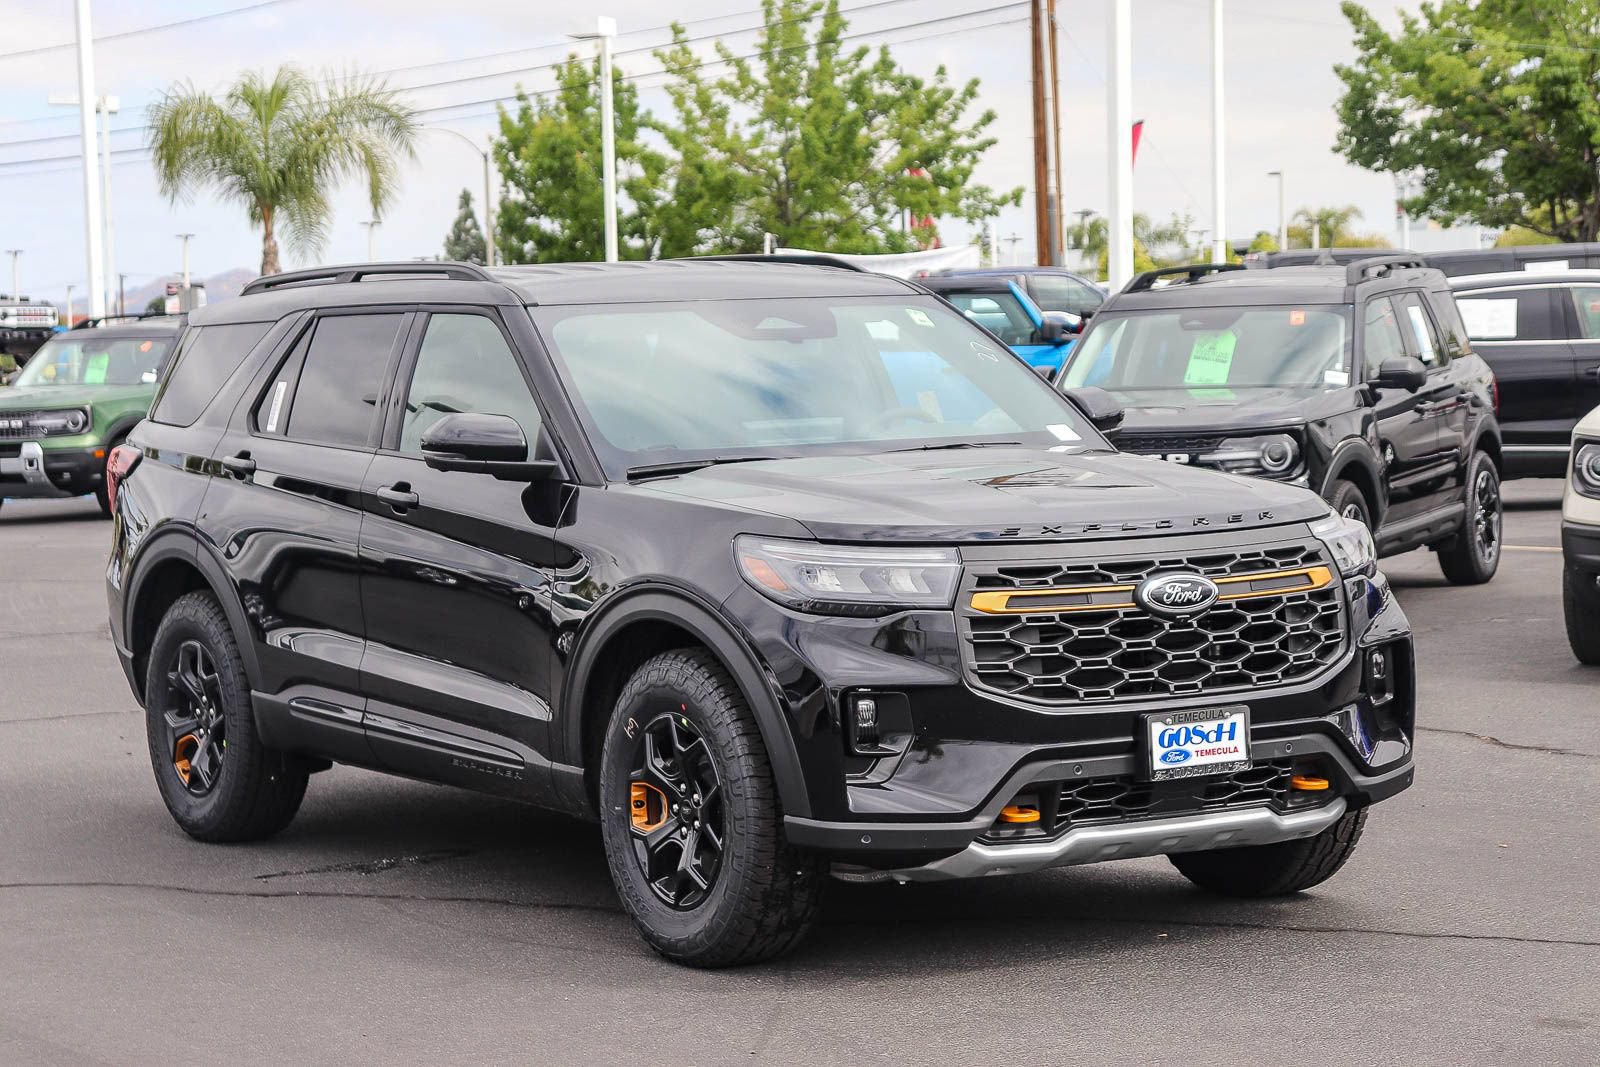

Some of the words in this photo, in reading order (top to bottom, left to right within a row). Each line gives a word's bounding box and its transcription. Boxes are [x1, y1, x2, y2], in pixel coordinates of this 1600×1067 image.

[1000, 510, 1274, 537] EXPLORER
[1163, 583, 1203, 603] Ford
[1172, 709, 1225, 722] TEMECULA
[1166, 752, 1185, 762] Ford
[1195, 746, 1239, 757] TEMECULA
